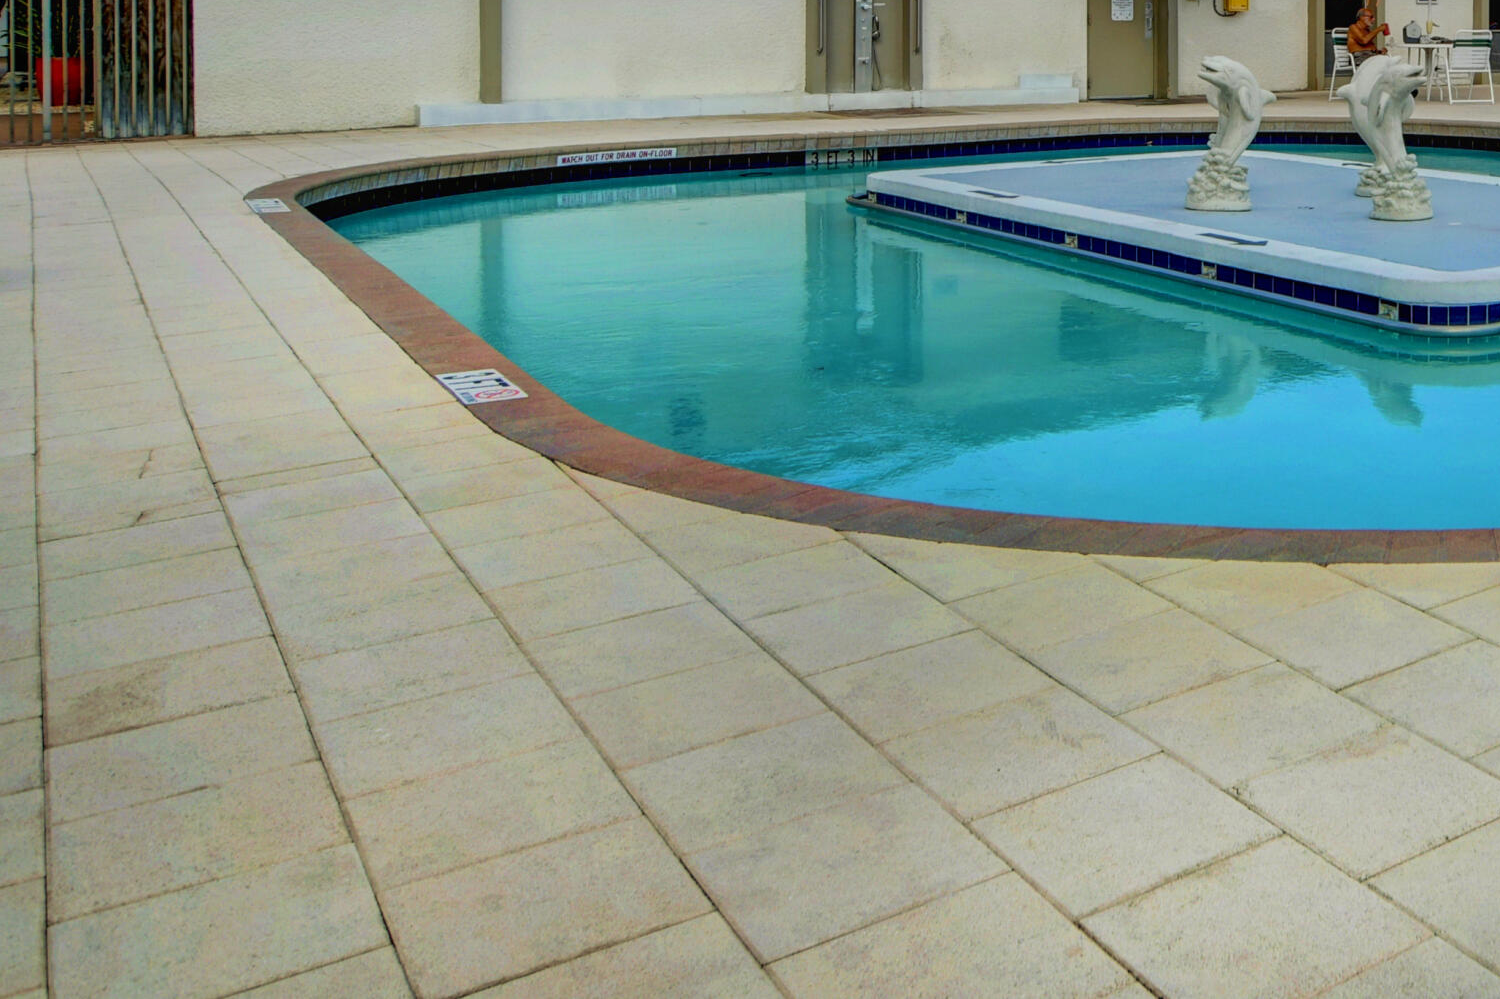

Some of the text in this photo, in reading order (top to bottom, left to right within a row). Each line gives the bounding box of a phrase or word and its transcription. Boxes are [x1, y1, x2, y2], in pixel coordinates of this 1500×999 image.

[561, 149, 673, 164] WATCH OUT FOR DRAIN ON-FLOOR
[811, 148, 874, 164] 3 FT 3 IN
